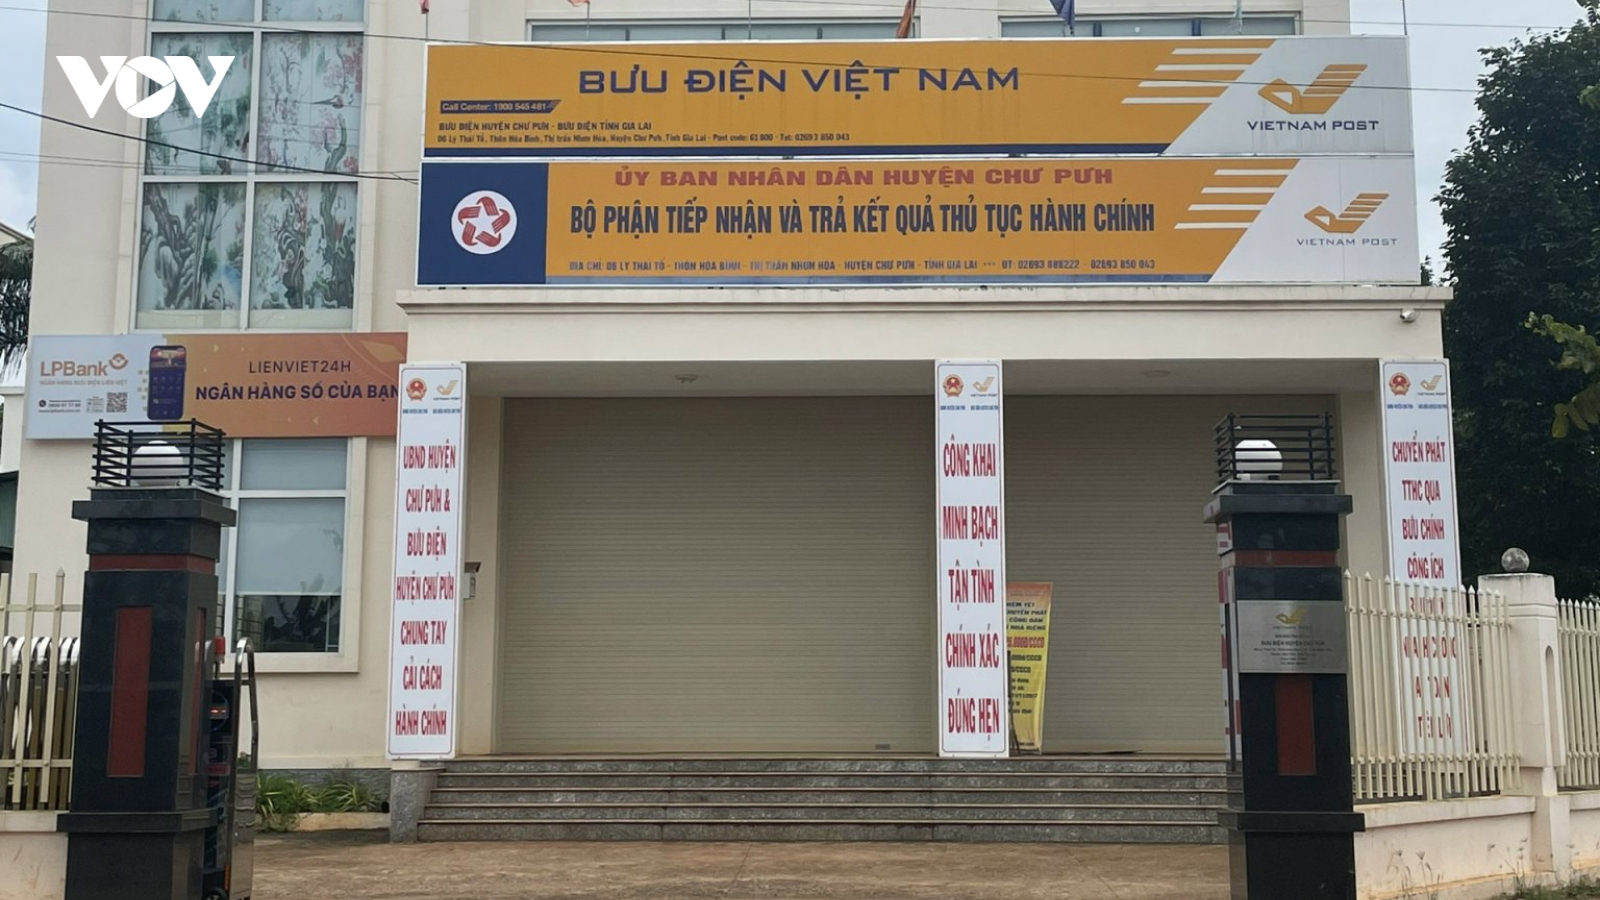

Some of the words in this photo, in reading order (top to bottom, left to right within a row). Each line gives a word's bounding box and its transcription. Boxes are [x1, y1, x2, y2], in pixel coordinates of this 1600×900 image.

[579, 64, 667, 93] BƯU
[684, 60, 786, 100] ĐIỆN
[801, 60, 900, 100] VIỆT
[919, 67, 1018, 91] NAM
[638, 122, 652, 130] LAI
[1247, 121, 1326, 131] VIETNAM
[1332, 121, 1379, 130] POST
[615, 165, 650, 186] ỦY
[661, 171, 717, 186] BAN
[728, 167, 805, 186] NHÂN
[816, 166, 873, 185] DÂN
[883, 166, 974, 188] HUYỆN
[985, 168, 1043, 184] CHƯ
[1055, 167, 1112, 184] PƯH
[571, 199, 596, 239] BỘ
[604, 199, 659, 239] PHẬN
[666, 196, 707, 233] TIẾP
[716, 199, 772, 239] NHẬN
[779, 198, 802, 233] VÀ
[809, 195, 847, 233] TRẢ
[854, 196, 889, 232] KẾT
[896, 194, 935, 235] QUẢ
[939, 194, 977, 232] THỦ
[985, 204, 1022, 238] TỤC
[1030, 198, 1086, 231] HÀNH
[1094, 198, 1154, 231] CHÍNH
[1297, 238, 1355, 246] VIETNAM
[1362, 238, 1398, 246] POST
[41, 361, 108, 376] LPBank
[249, 361, 350, 373] LIENVIET24H
[196, 382, 243, 400] NGÂN
[247, 382, 296, 400] HÀNG
[301, 381, 323, 399] SỐ
[328, 380, 362, 399] CỦA
[367, 385, 398, 402] BẠN
[403, 445, 425, 469] UBND
[428, 439, 456, 473] HUYỆN
[943, 434, 970, 477] CÔNG
[973, 443, 996, 476] KHAI
[1392, 430, 1424, 462] CHUYỂN
[1426, 437, 1446, 462] PHÁT
[406, 485, 423, 512] CHƯ
[425, 484, 442, 512] PƯH
[444, 488, 450, 512] &
[1402, 480, 1422, 501] TTHC
[1425, 480, 1441, 504] QUA
[943, 506, 967, 539] MINH
[972, 506, 998, 547] BẠCH
[1402, 514, 1418, 540] BƯU
[1421, 513, 1444, 540] CHÍNH
[407, 527, 424, 556] BƯU
[427, 526, 446, 560] ĐIỆN
[1407, 552, 1429, 579] CÔNG
[1431, 552, 1444, 579] ÍCH
[396, 570, 421, 605] HUYỆN
[422, 572, 438, 600] CHƯ
[439, 571, 454, 600] PƯH
[948, 560, 968, 611] TẬN
[971, 560, 994, 603] TÌNH
[401, 621, 428, 645] CHUNG
[431, 621, 447, 645] TAY
[946, 624, 976, 668] CHÍNH
[979, 624, 999, 668] XÁC
[403, 656, 417, 690] CẢI
[420, 659, 442, 690] CÁCH
[395, 704, 418, 735] HÀNH
[421, 704, 447, 735] CHÍNH
[948, 688, 975, 733] ĐÚNG
[979, 698, 999, 741] HẸN
